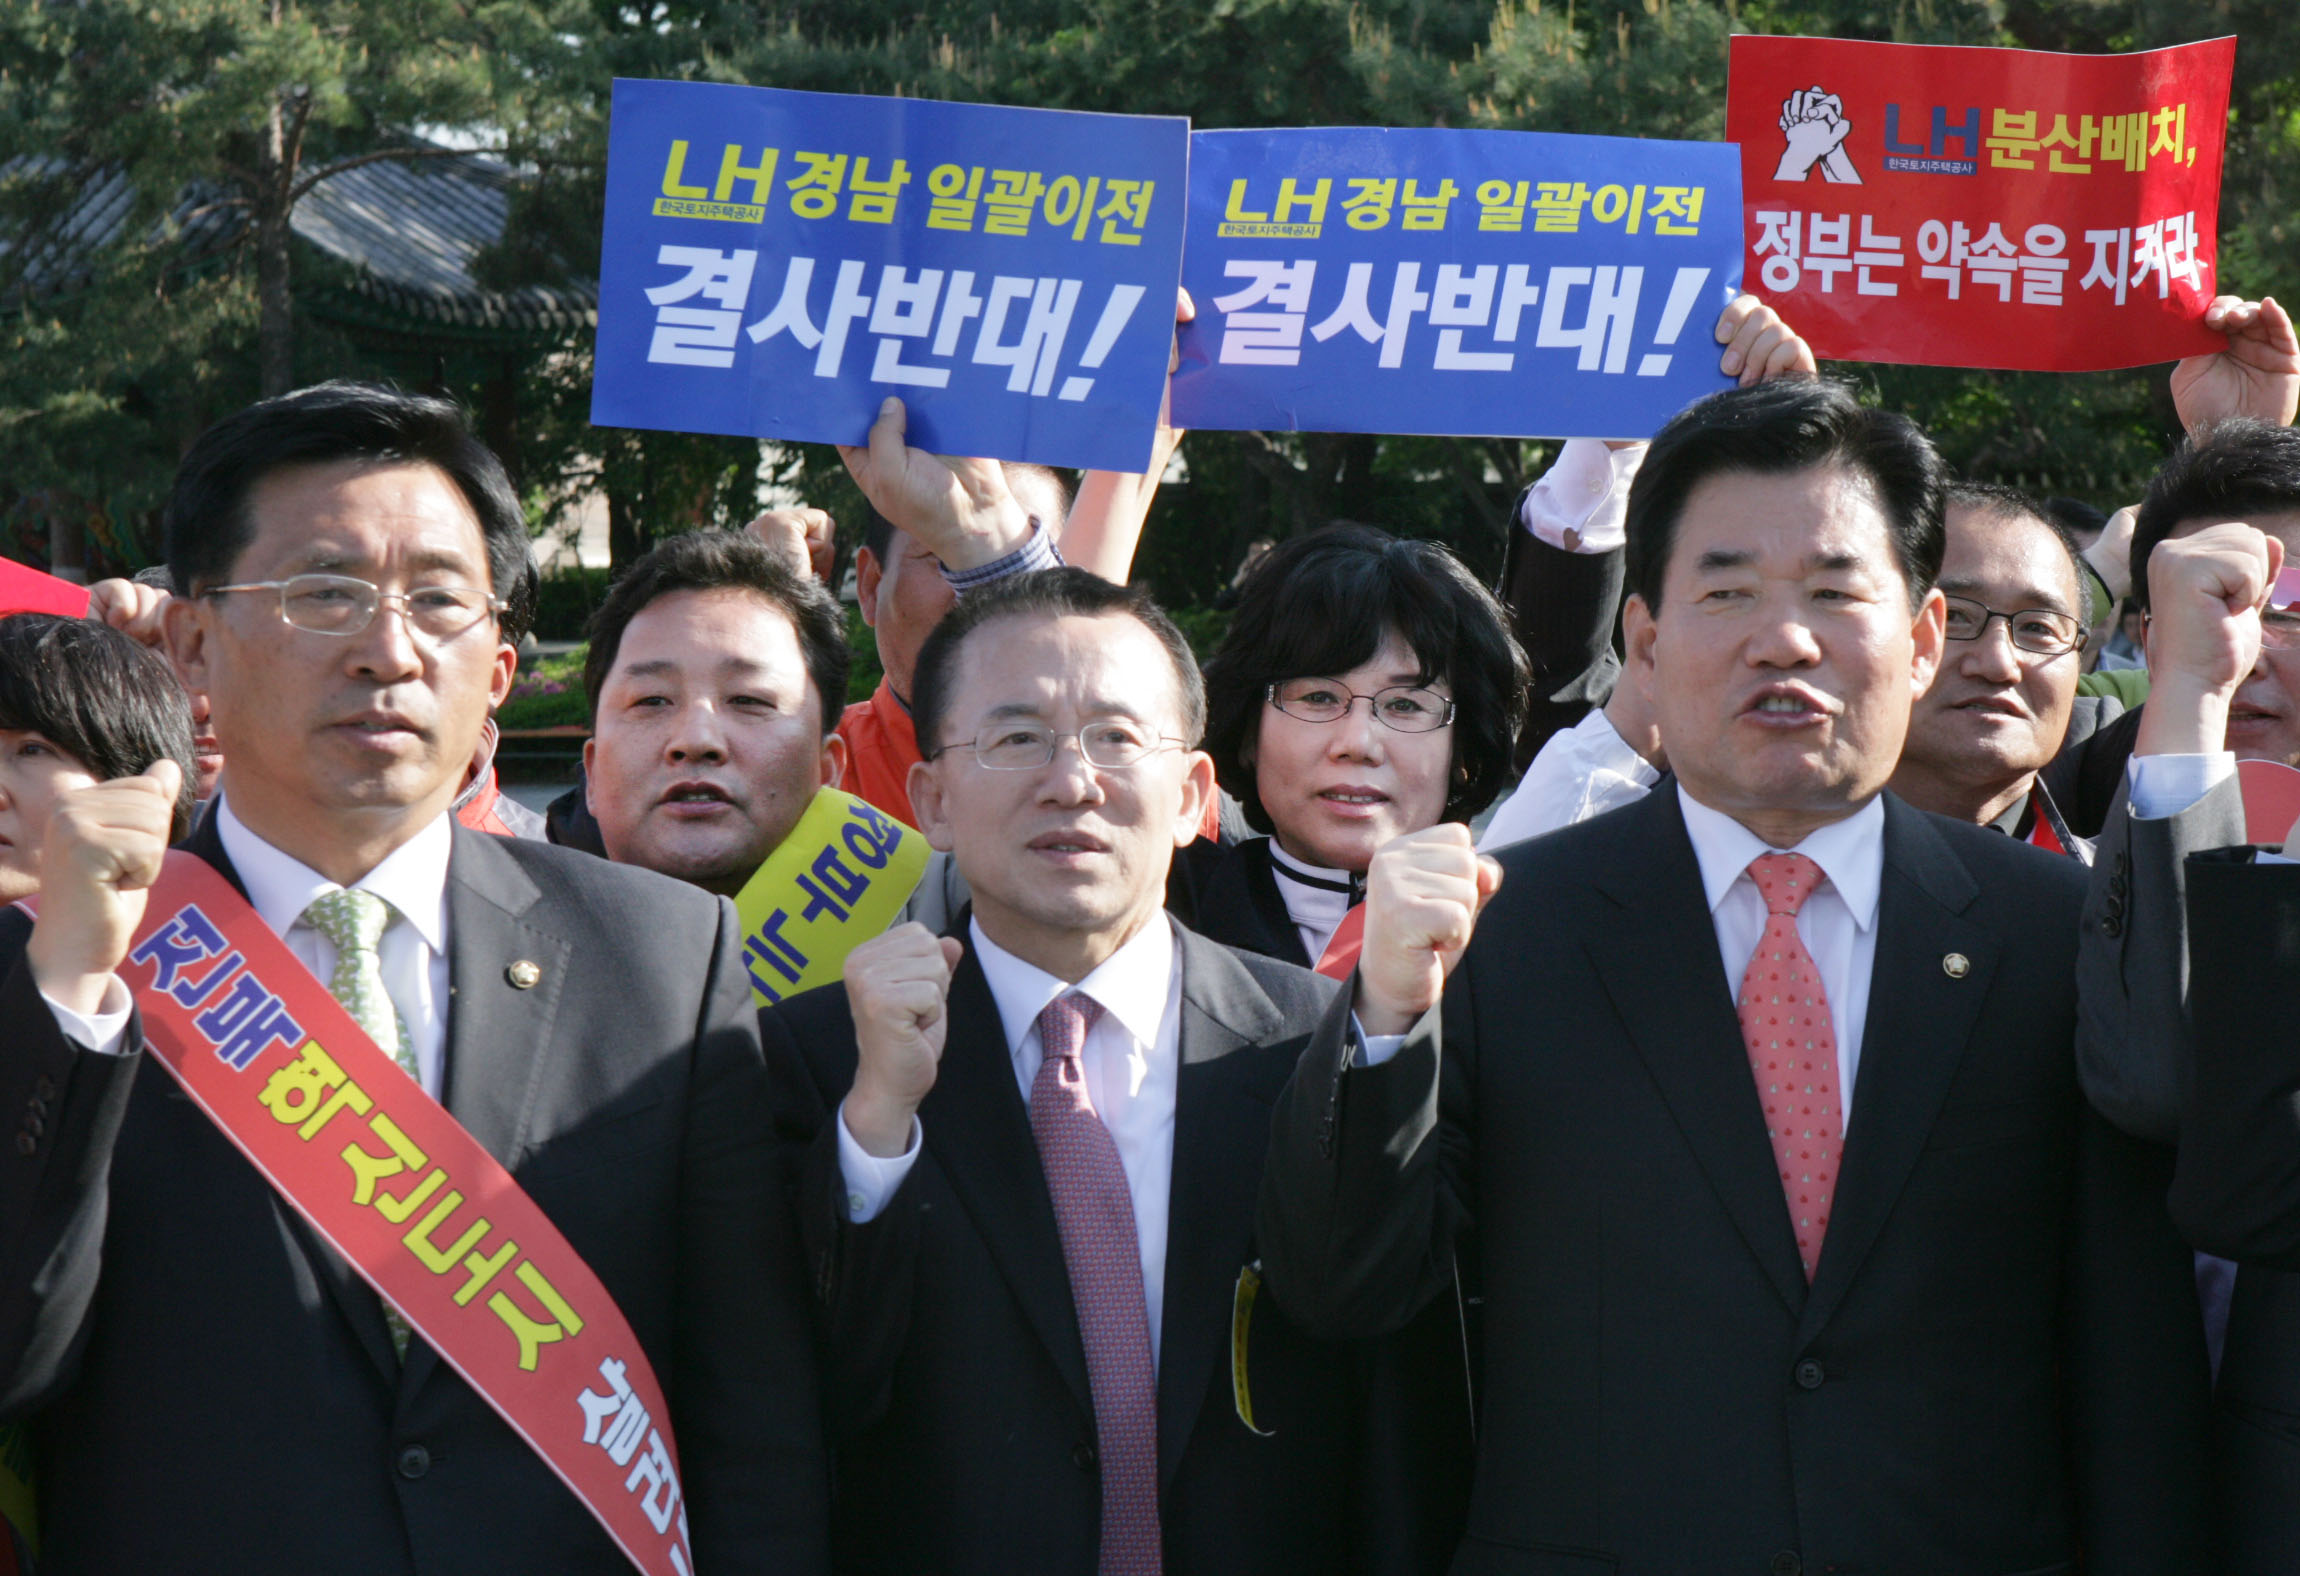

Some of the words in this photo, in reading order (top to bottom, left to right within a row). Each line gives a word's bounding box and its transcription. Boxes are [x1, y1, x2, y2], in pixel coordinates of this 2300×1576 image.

[1885, 103, 1980, 157] LH
[1985, 103, 2196, 174] 분산배치,
[1888, 157, 1973, 174] 한국토지주택공사
[659, 199, 760, 221] 한국토지주택공사
[661, 139, 779, 205] LH
[786, 151, 911, 225] 경남
[926, 163, 1155, 246] 일괄이전
[1224, 178, 1332, 223] LH
[1340, 177, 1459, 231] 경남
[1475, 180, 1705, 236] 일괄이전
[1223, 224, 1317, 237] 한국토지주택공사
[1753, 210, 1904, 296] 정부는
[1917, 219, 2070, 306] 약속을
[2080, 211, 2202, 306] 지켜라
[644, 244, 1147, 401] 결사반대!
[1213, 259, 1712, 376] 결사반대!
